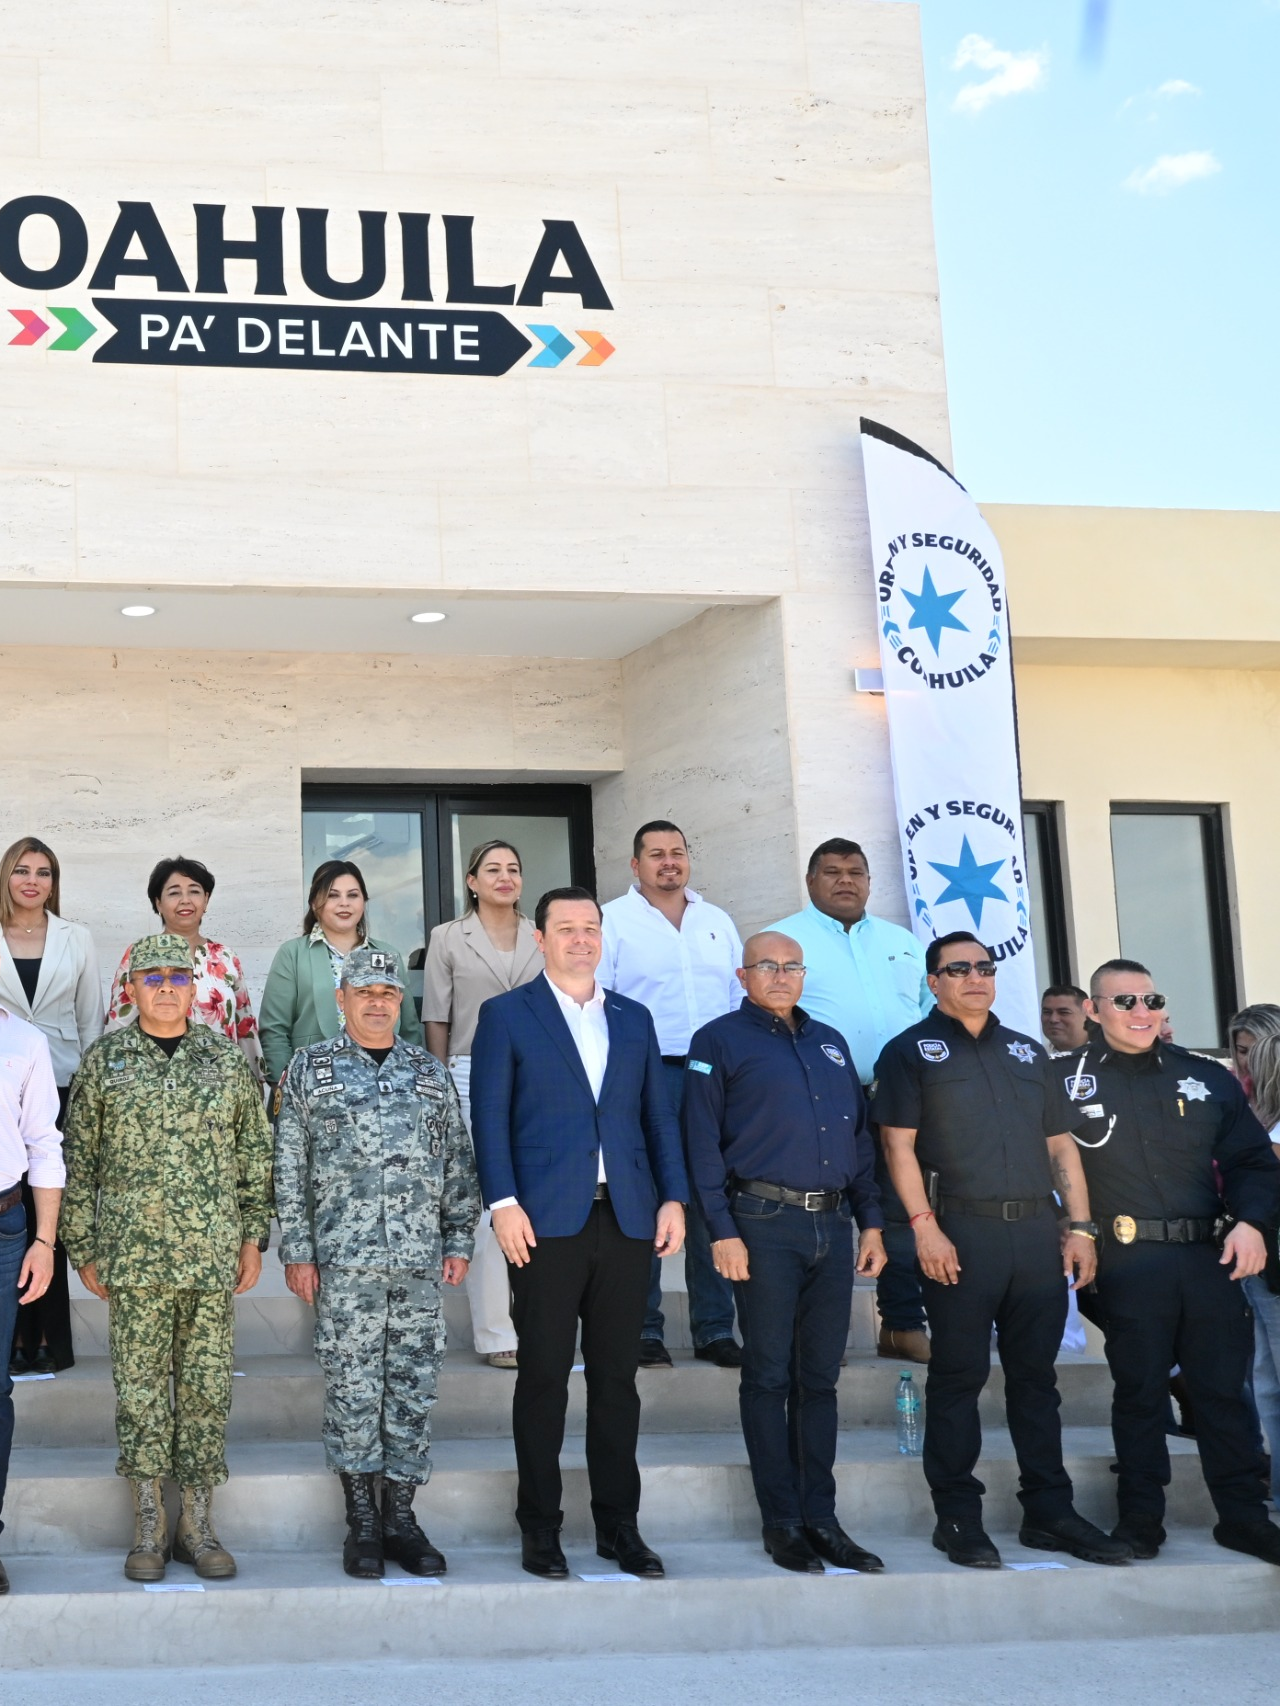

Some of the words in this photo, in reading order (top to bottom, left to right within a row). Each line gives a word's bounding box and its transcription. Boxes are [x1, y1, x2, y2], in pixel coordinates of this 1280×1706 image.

[237, 318, 481, 361] DELANTE
[911, 532, 1002, 613] SEGURIDAD
[897, 646, 997, 690] COHUILA
[923, 803, 941, 821] Y
